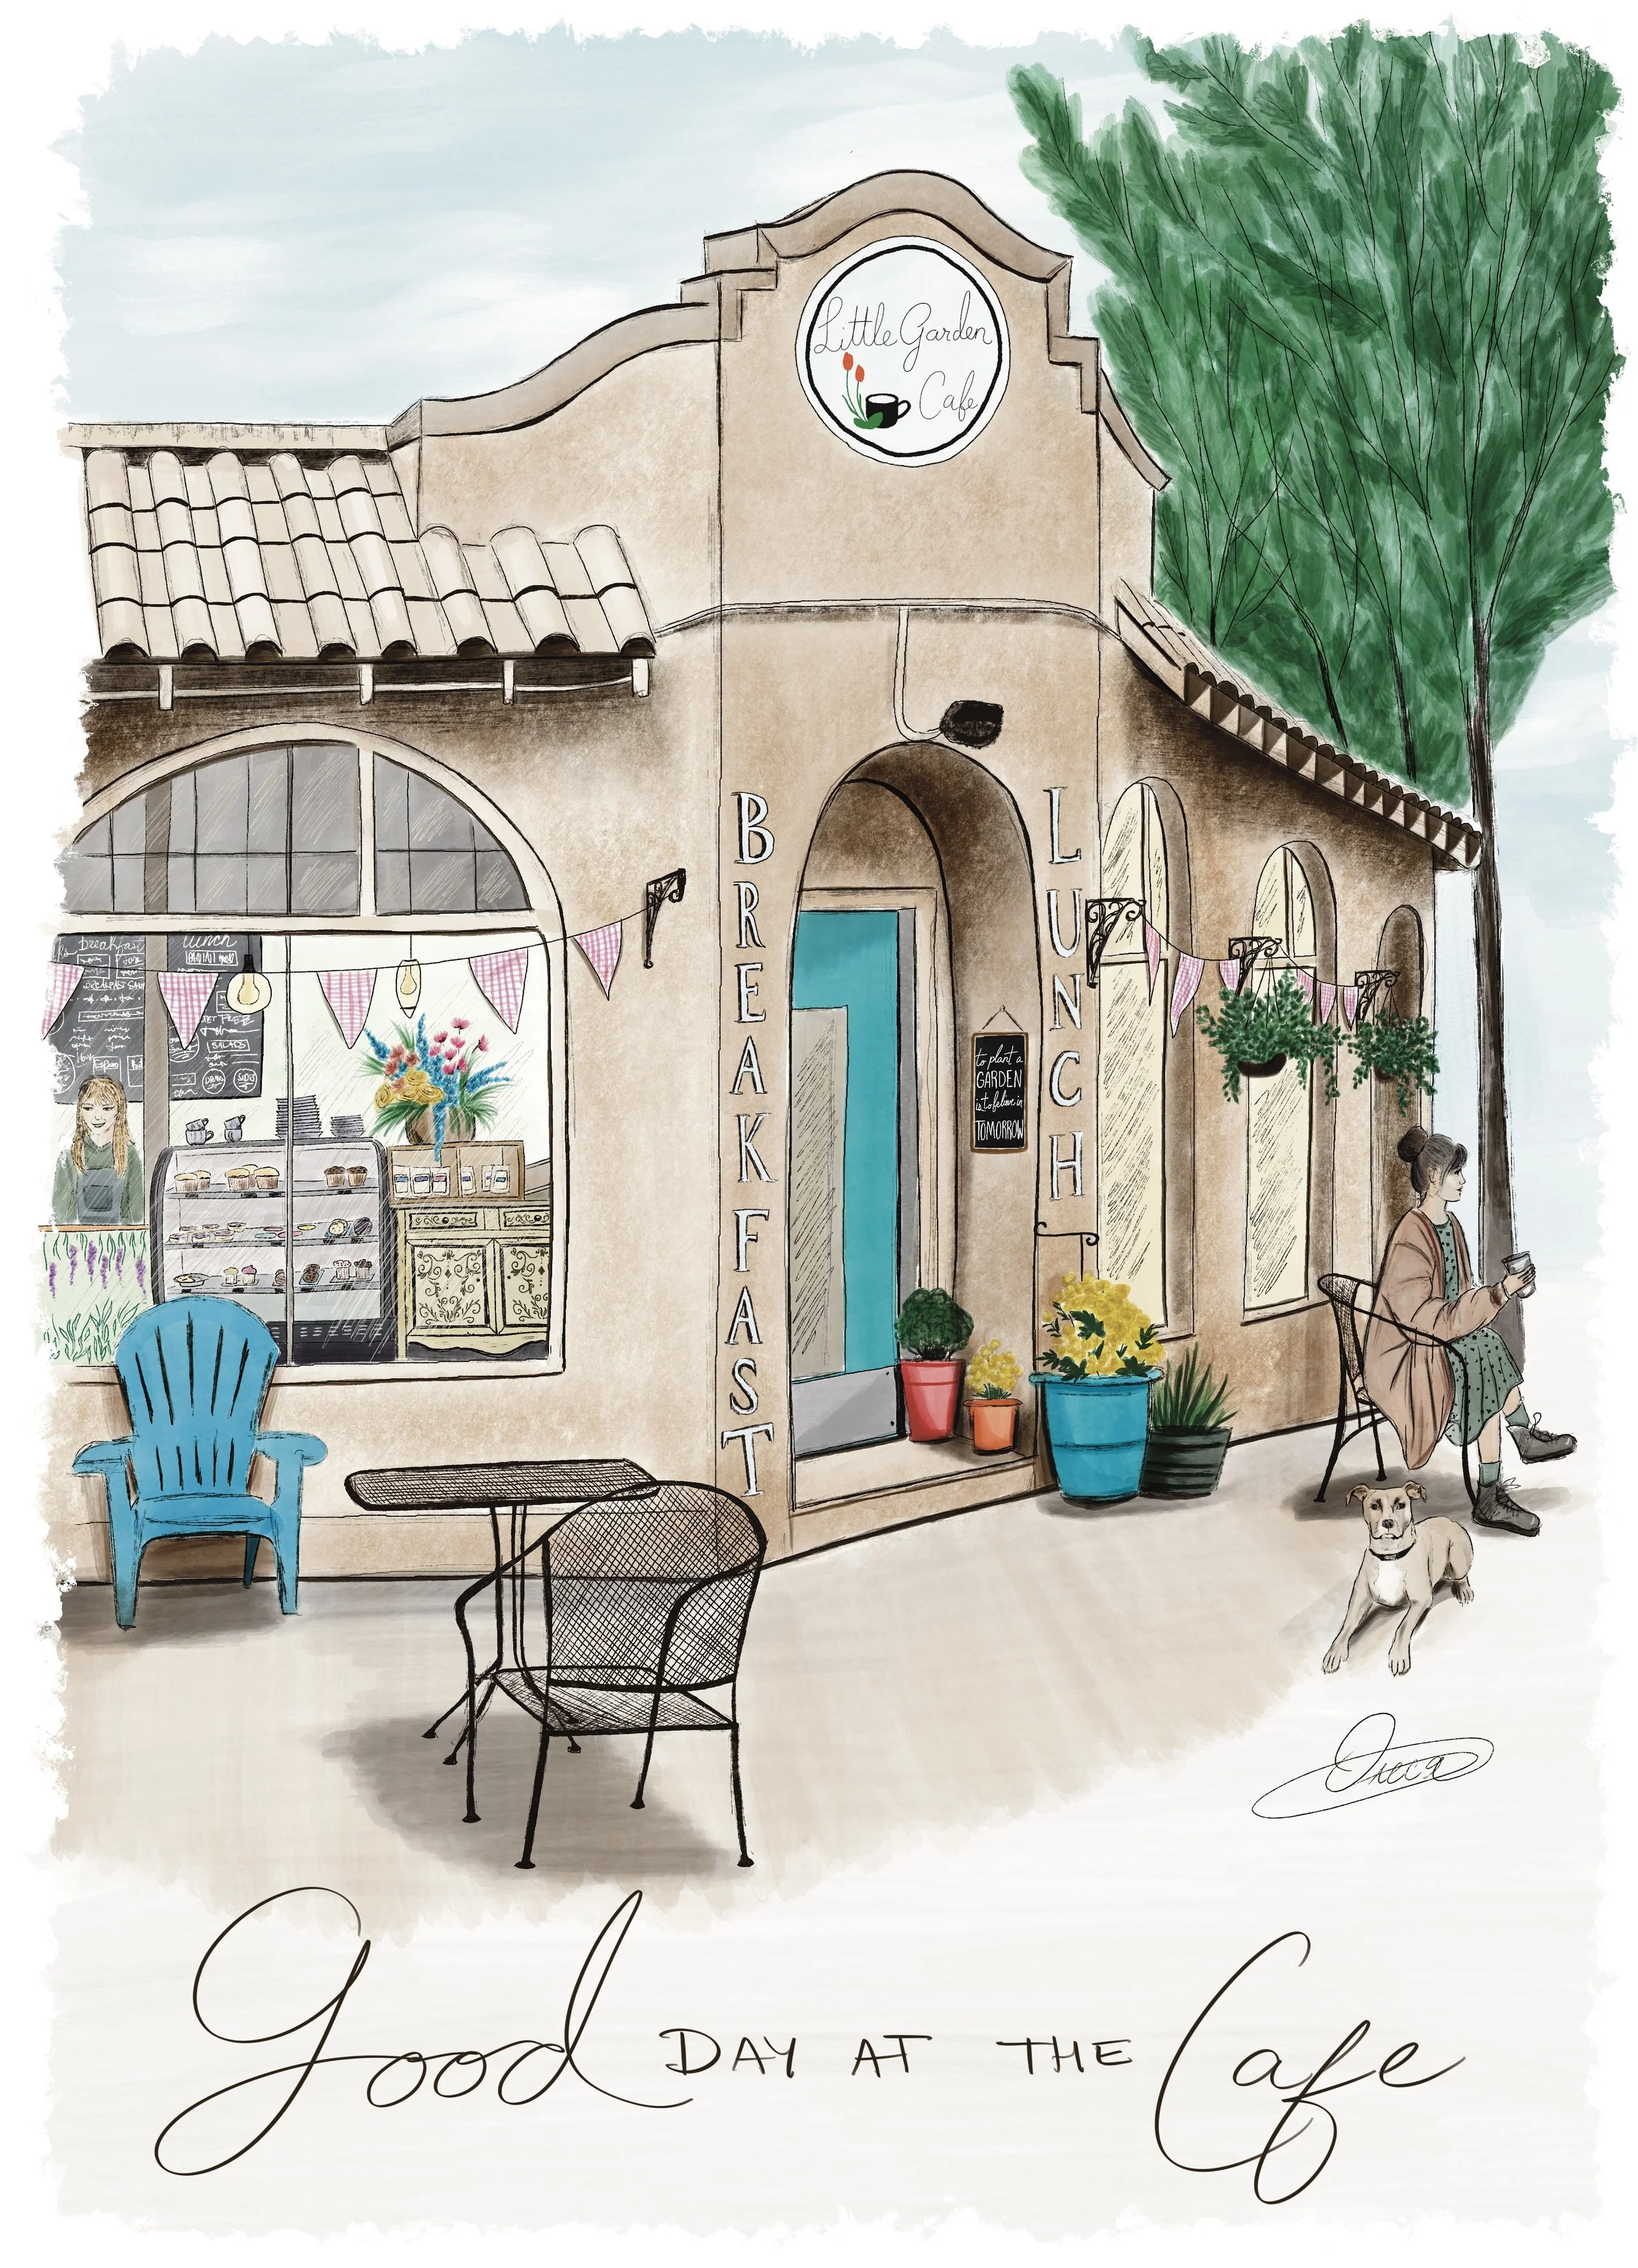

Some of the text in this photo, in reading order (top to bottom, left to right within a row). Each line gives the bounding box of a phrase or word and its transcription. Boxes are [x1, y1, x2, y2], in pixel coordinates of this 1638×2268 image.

[814, 290, 993, 372] Little Garden
[919, 370, 978, 421] Cafe
[79, 934, 145, 962] breakfast
[183, 934, 237, 948] lunch
[188, 952, 216, 964] PANINI
[83, 978, 126, 990] BREAKFAST
[1042, 786, 1085, 1201] LUNCH
[976, 1048, 987, 1067] to
[987, 1044, 1018, 1070] plant
[205, 1075, 225, 1085] DRINKS
[237, 1073, 256, 1082] SIDES
[976, 1069, 1022, 1088] GARDEN
[981, 1092, 993, 1109] to
[1016, 1096, 1023, 1108] in
[975, 1119, 1024, 1141] TOMORROW
[721, 791, 778, 1498] BREAKFAST
[154, 1886, 1466, 2204] Good DAY AT THE Cafe
